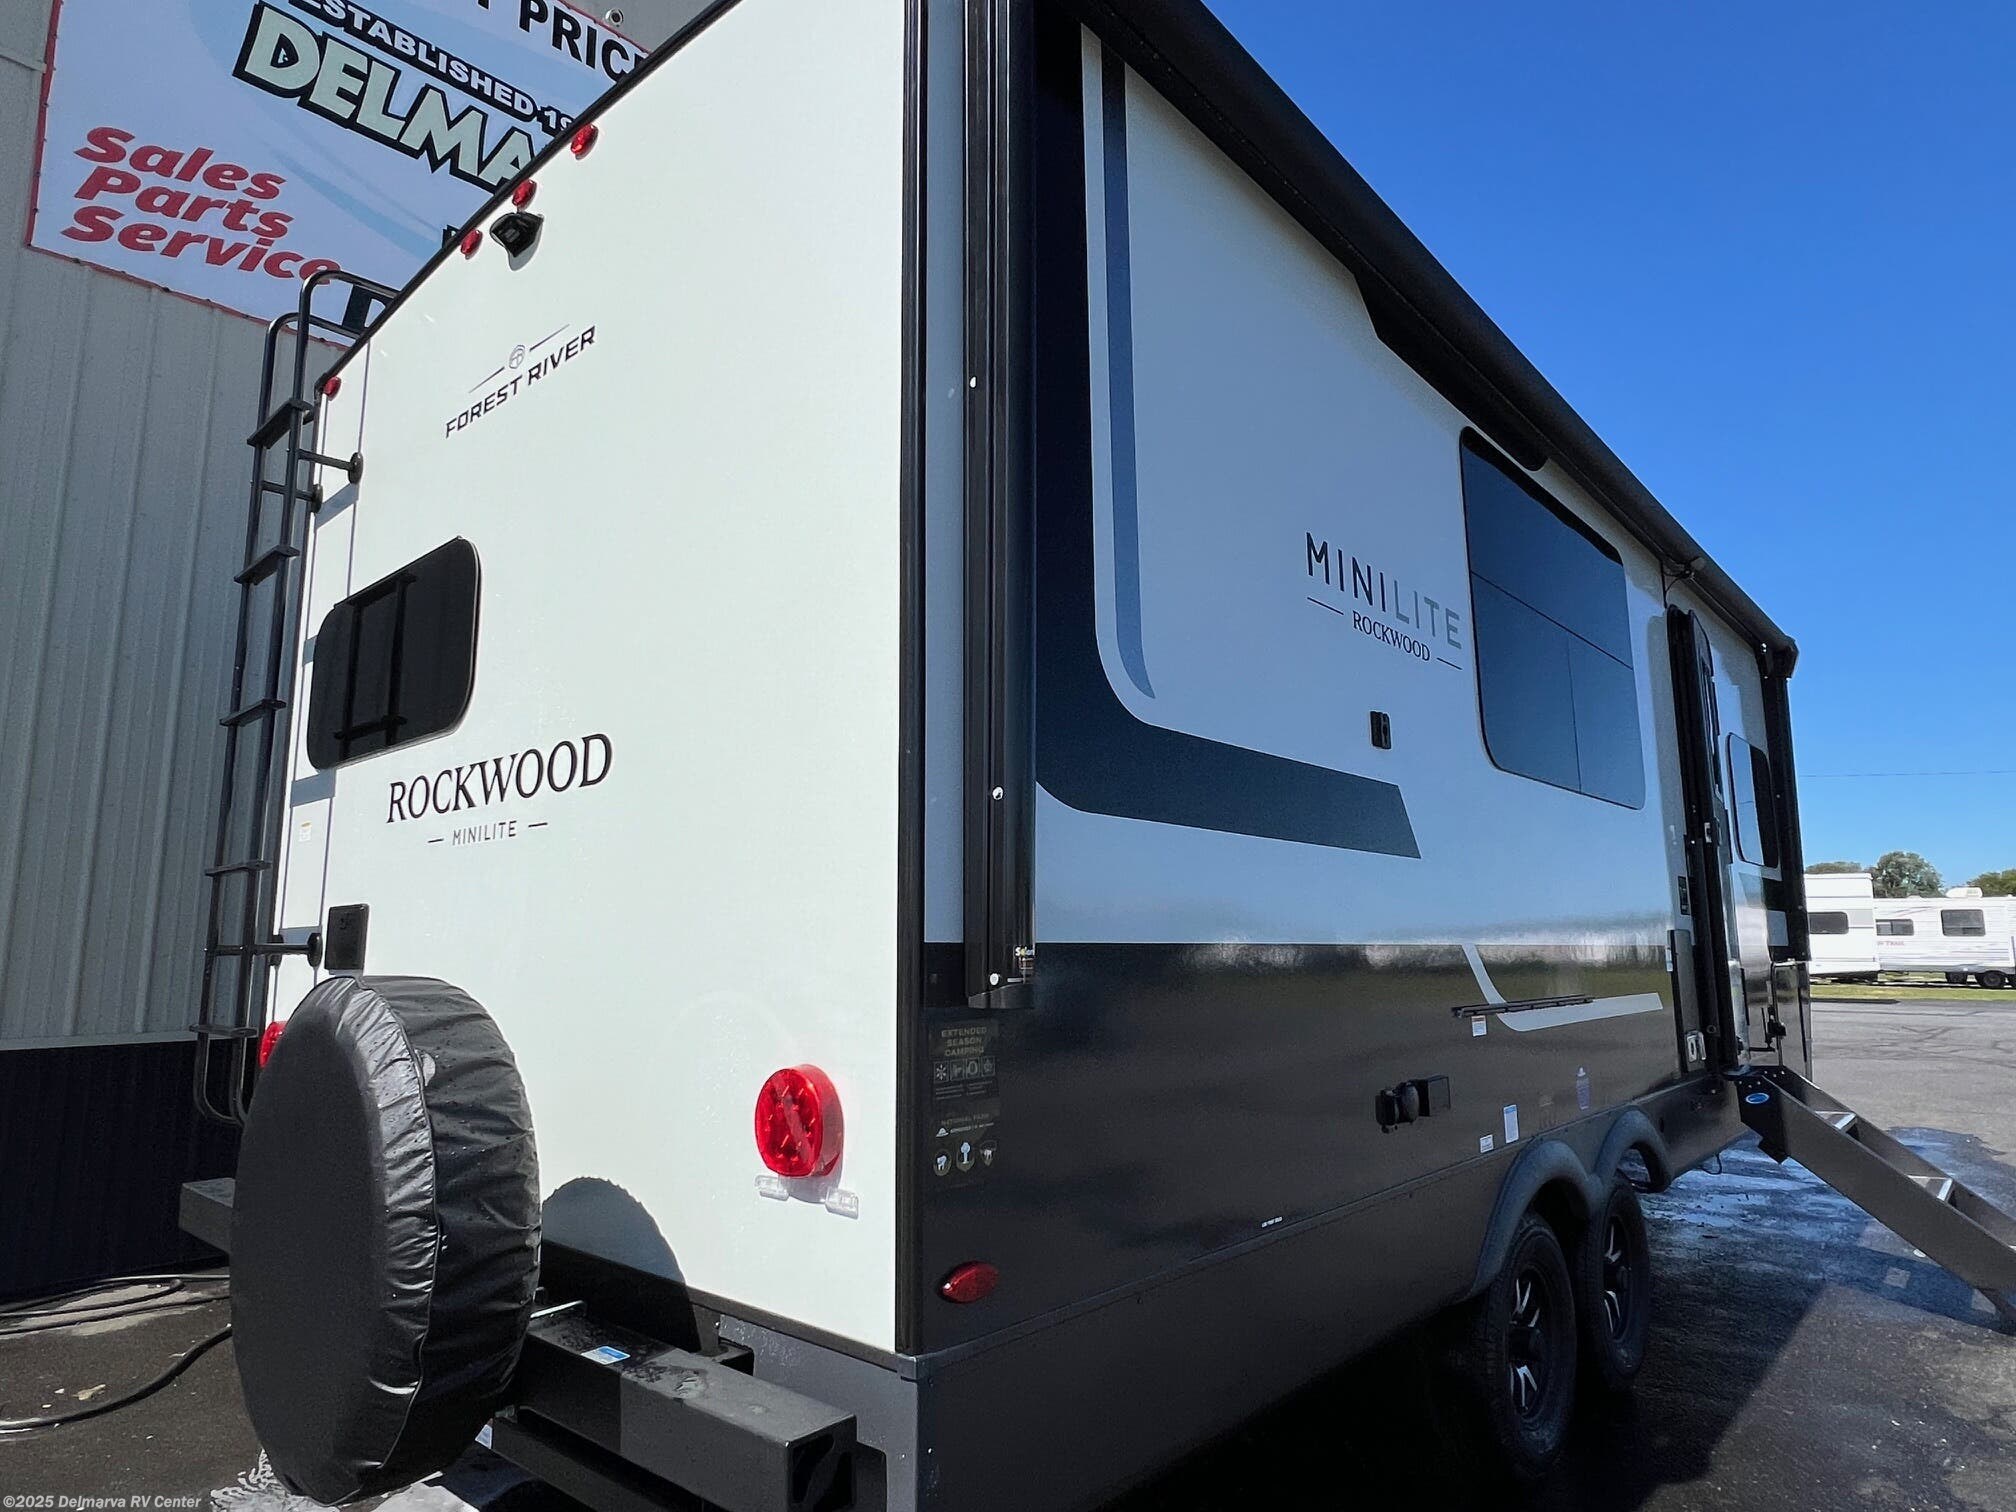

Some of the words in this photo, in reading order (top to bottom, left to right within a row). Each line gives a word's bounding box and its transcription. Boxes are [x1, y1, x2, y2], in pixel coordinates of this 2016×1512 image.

[74, 126, 287, 199] Sales
[74, 165, 295, 239] Parts
[445, 374, 523, 439] FOREST
[527, 325, 596, 386] RIVER
[1306, 531, 1463, 650] MINILITE
[1352, 610, 1431, 661] ROCKWOOD
[386, 733, 613, 824] ROCKWOOD
[452, 820, 518, 846] MINILITE
